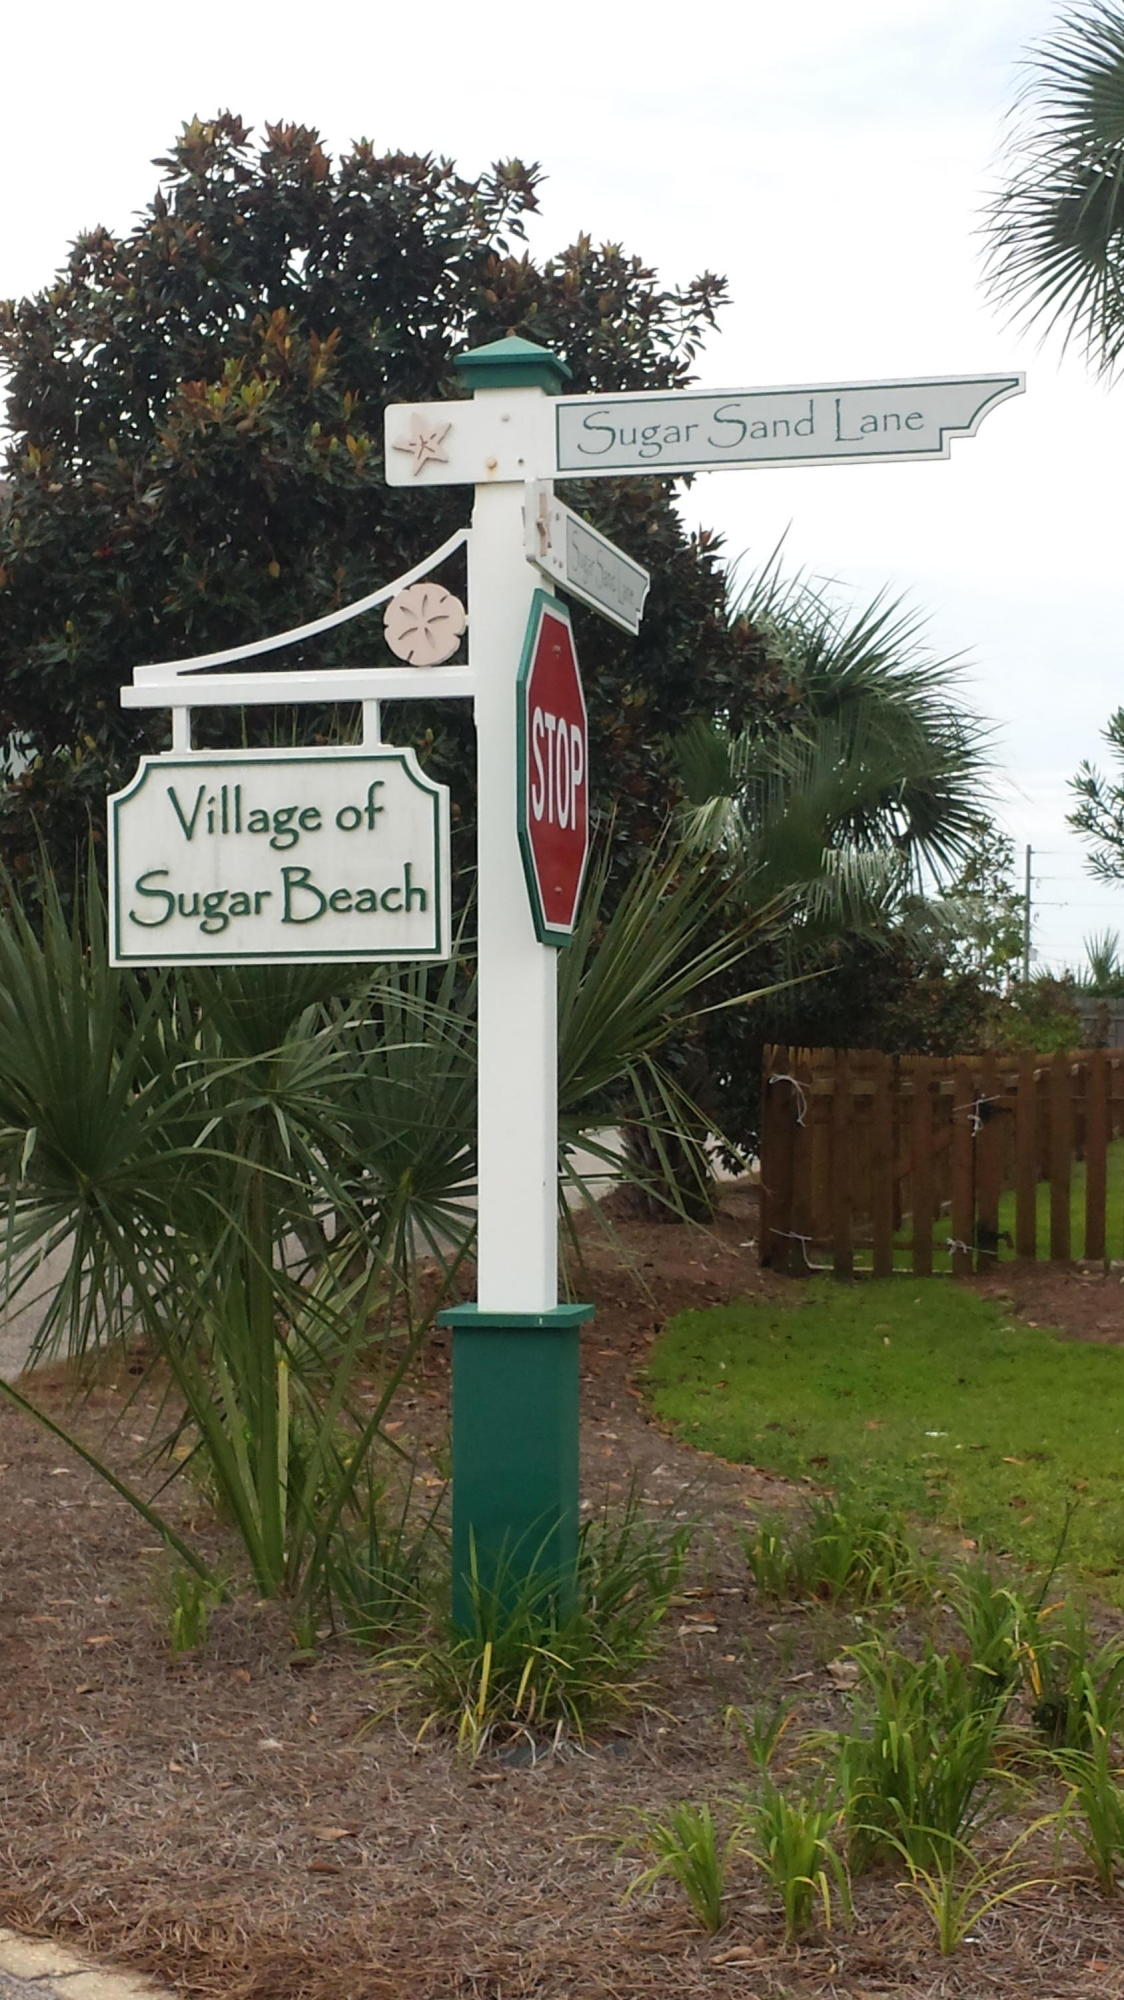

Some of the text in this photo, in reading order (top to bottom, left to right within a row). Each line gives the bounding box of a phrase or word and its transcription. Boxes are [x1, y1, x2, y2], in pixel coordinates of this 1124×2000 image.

[577, 398, 925, 458] Sugar Sand Lane
[531, 706, 583, 831] STOP
[167, 781, 385, 850] Village of
[129, 862, 427, 934] Sugar Beach
